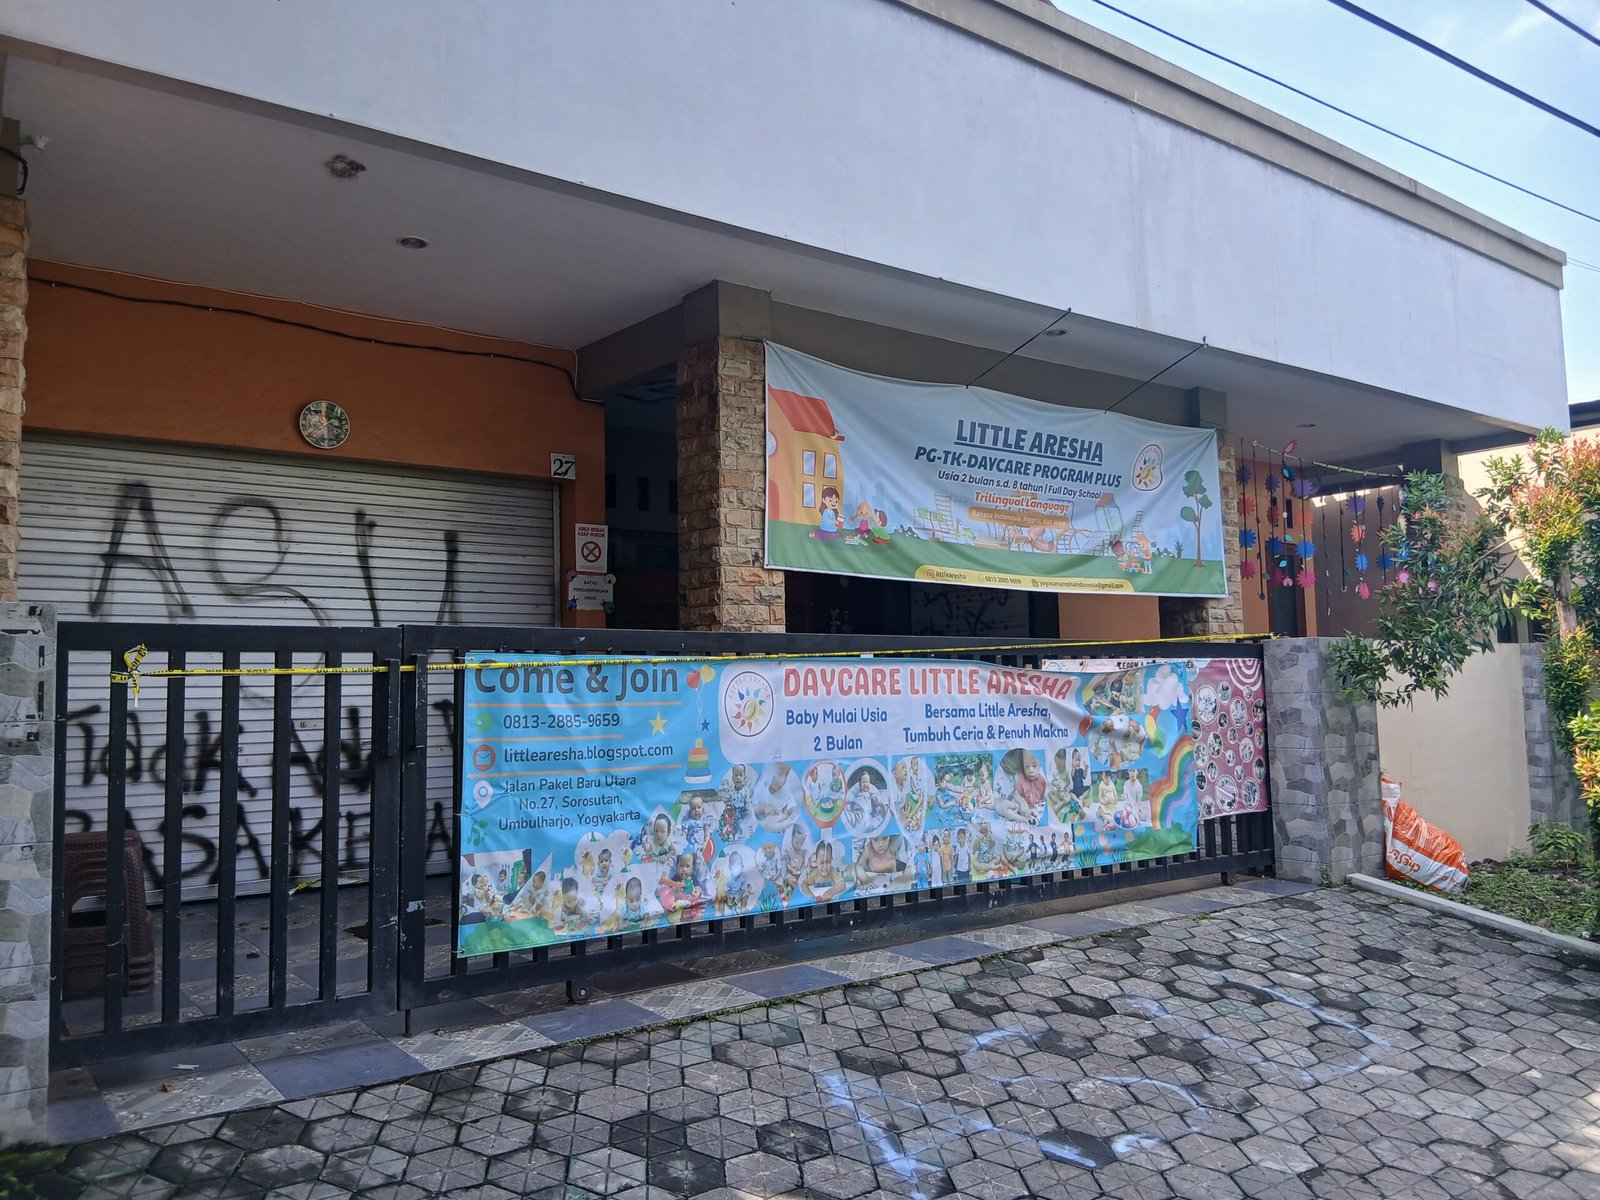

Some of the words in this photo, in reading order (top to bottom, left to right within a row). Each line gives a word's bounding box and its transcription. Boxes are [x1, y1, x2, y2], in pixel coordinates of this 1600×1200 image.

[956, 419, 1028, 451] LITTLE
[1028, 431, 1103, 462] ARESHA
[553, 458, 575, 477] 27
[914, 446, 1032, 476] PG-TK-DAYCARE
[1032, 463, 1094, 485] PROGRAM
[1094, 472, 1122, 488] PLUS
[938, 470, 960, 482] Usia
[961, 473, 967, 483] 2
[968, 474, 995, 487] bulan
[995, 478, 1011, 489] s.d.
[1012, 480, 1018, 489] 8
[1019, 481, 1044, 493] tahun
[1048, 485, 1062, 495] Full
[1062, 487, 1078, 499] Day
[1078, 489, 1102, 499] School
[975, 491, 1024, 508] Trilingual
[1025, 499, 1070, 513] Language
[475, 660, 575, 694] Come
[585, 664, 609, 693] &
[616, 662, 679, 702] Join
[783, 667, 902, 697] DAYCARE
[909, 668, 980, 696] LITTLE
[986, 670, 1074, 701] ARESHA
[503, 713, 620, 729] 0813-2885-9659
[785, 708, 821, 728] Baby
[822, 707, 858, 723] Mulai
[860, 707, 888, 723] Usia
[924, 703, 976, 719] Bersama
[977, 702, 1005, 718] Little
[1006, 702, 1051, 719] Aresha,
[813, 736, 822, 751] 2
[825, 735, 863, 751] Bulan
[903, 726, 951, 744] Tumbuh
[952, 725, 985, 742] Ceria
[986, 725, 996, 740] &
[998, 724, 1031, 740] Penuh
[1032, 723, 1069, 739] Makna
[504, 744, 674, 764] littlearesha.blogspot.com
[504, 780, 534, 794] Jalan
[539, 777, 573, 791] Pakel
[576, 777, 601, 789] Baru
[604, 774, 637, 787] Utara
[519, 798, 558, 811] No.27,
[562, 794, 624, 809] Sorosutan,
[499, 815, 574, 832] Umbulharjo,
[577, 810, 641, 827] Yogyakarta
